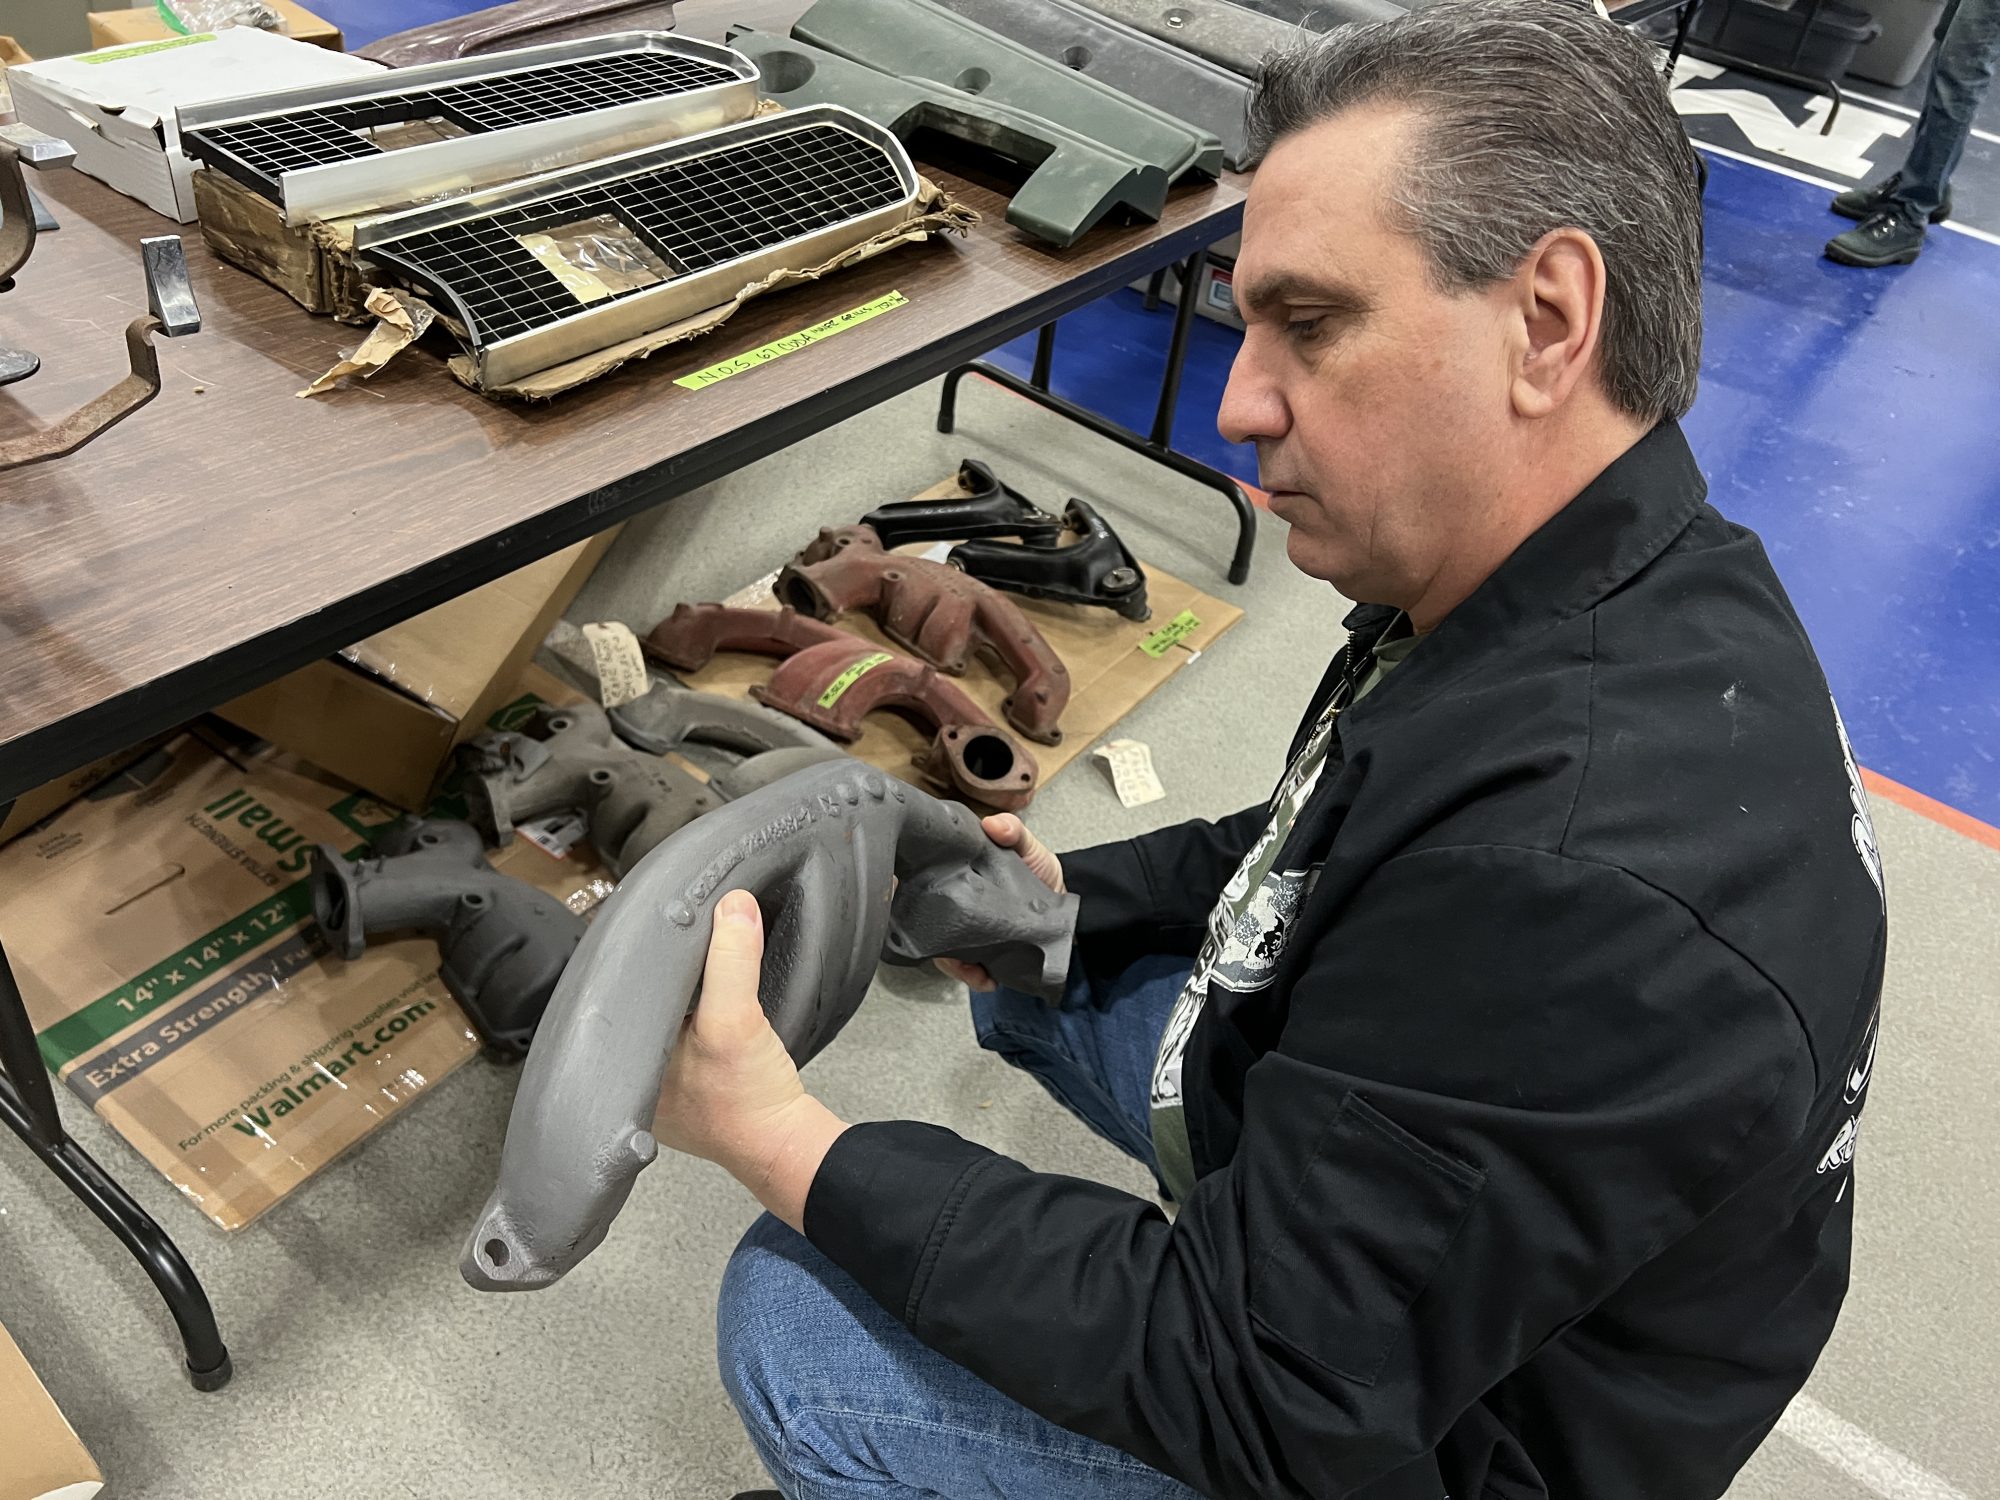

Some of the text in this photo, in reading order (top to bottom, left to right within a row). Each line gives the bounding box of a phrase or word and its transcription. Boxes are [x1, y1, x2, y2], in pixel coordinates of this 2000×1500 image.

[203, 788, 320, 873] Small
[165, 968, 187, 986] x
[229, 930, 250, 946] x
[84, 1039, 161, 1089] Extra
[159, 969, 272, 1045] Strength
[231, 1000, 437, 1138] Walmart.com
[178, 1131, 203, 1152] For
[203, 1107, 240, 1136] more
[240, 1071, 293, 1112] packing
[288, 1063, 302, 1075] &
[301, 1028, 355, 1068] shipping
